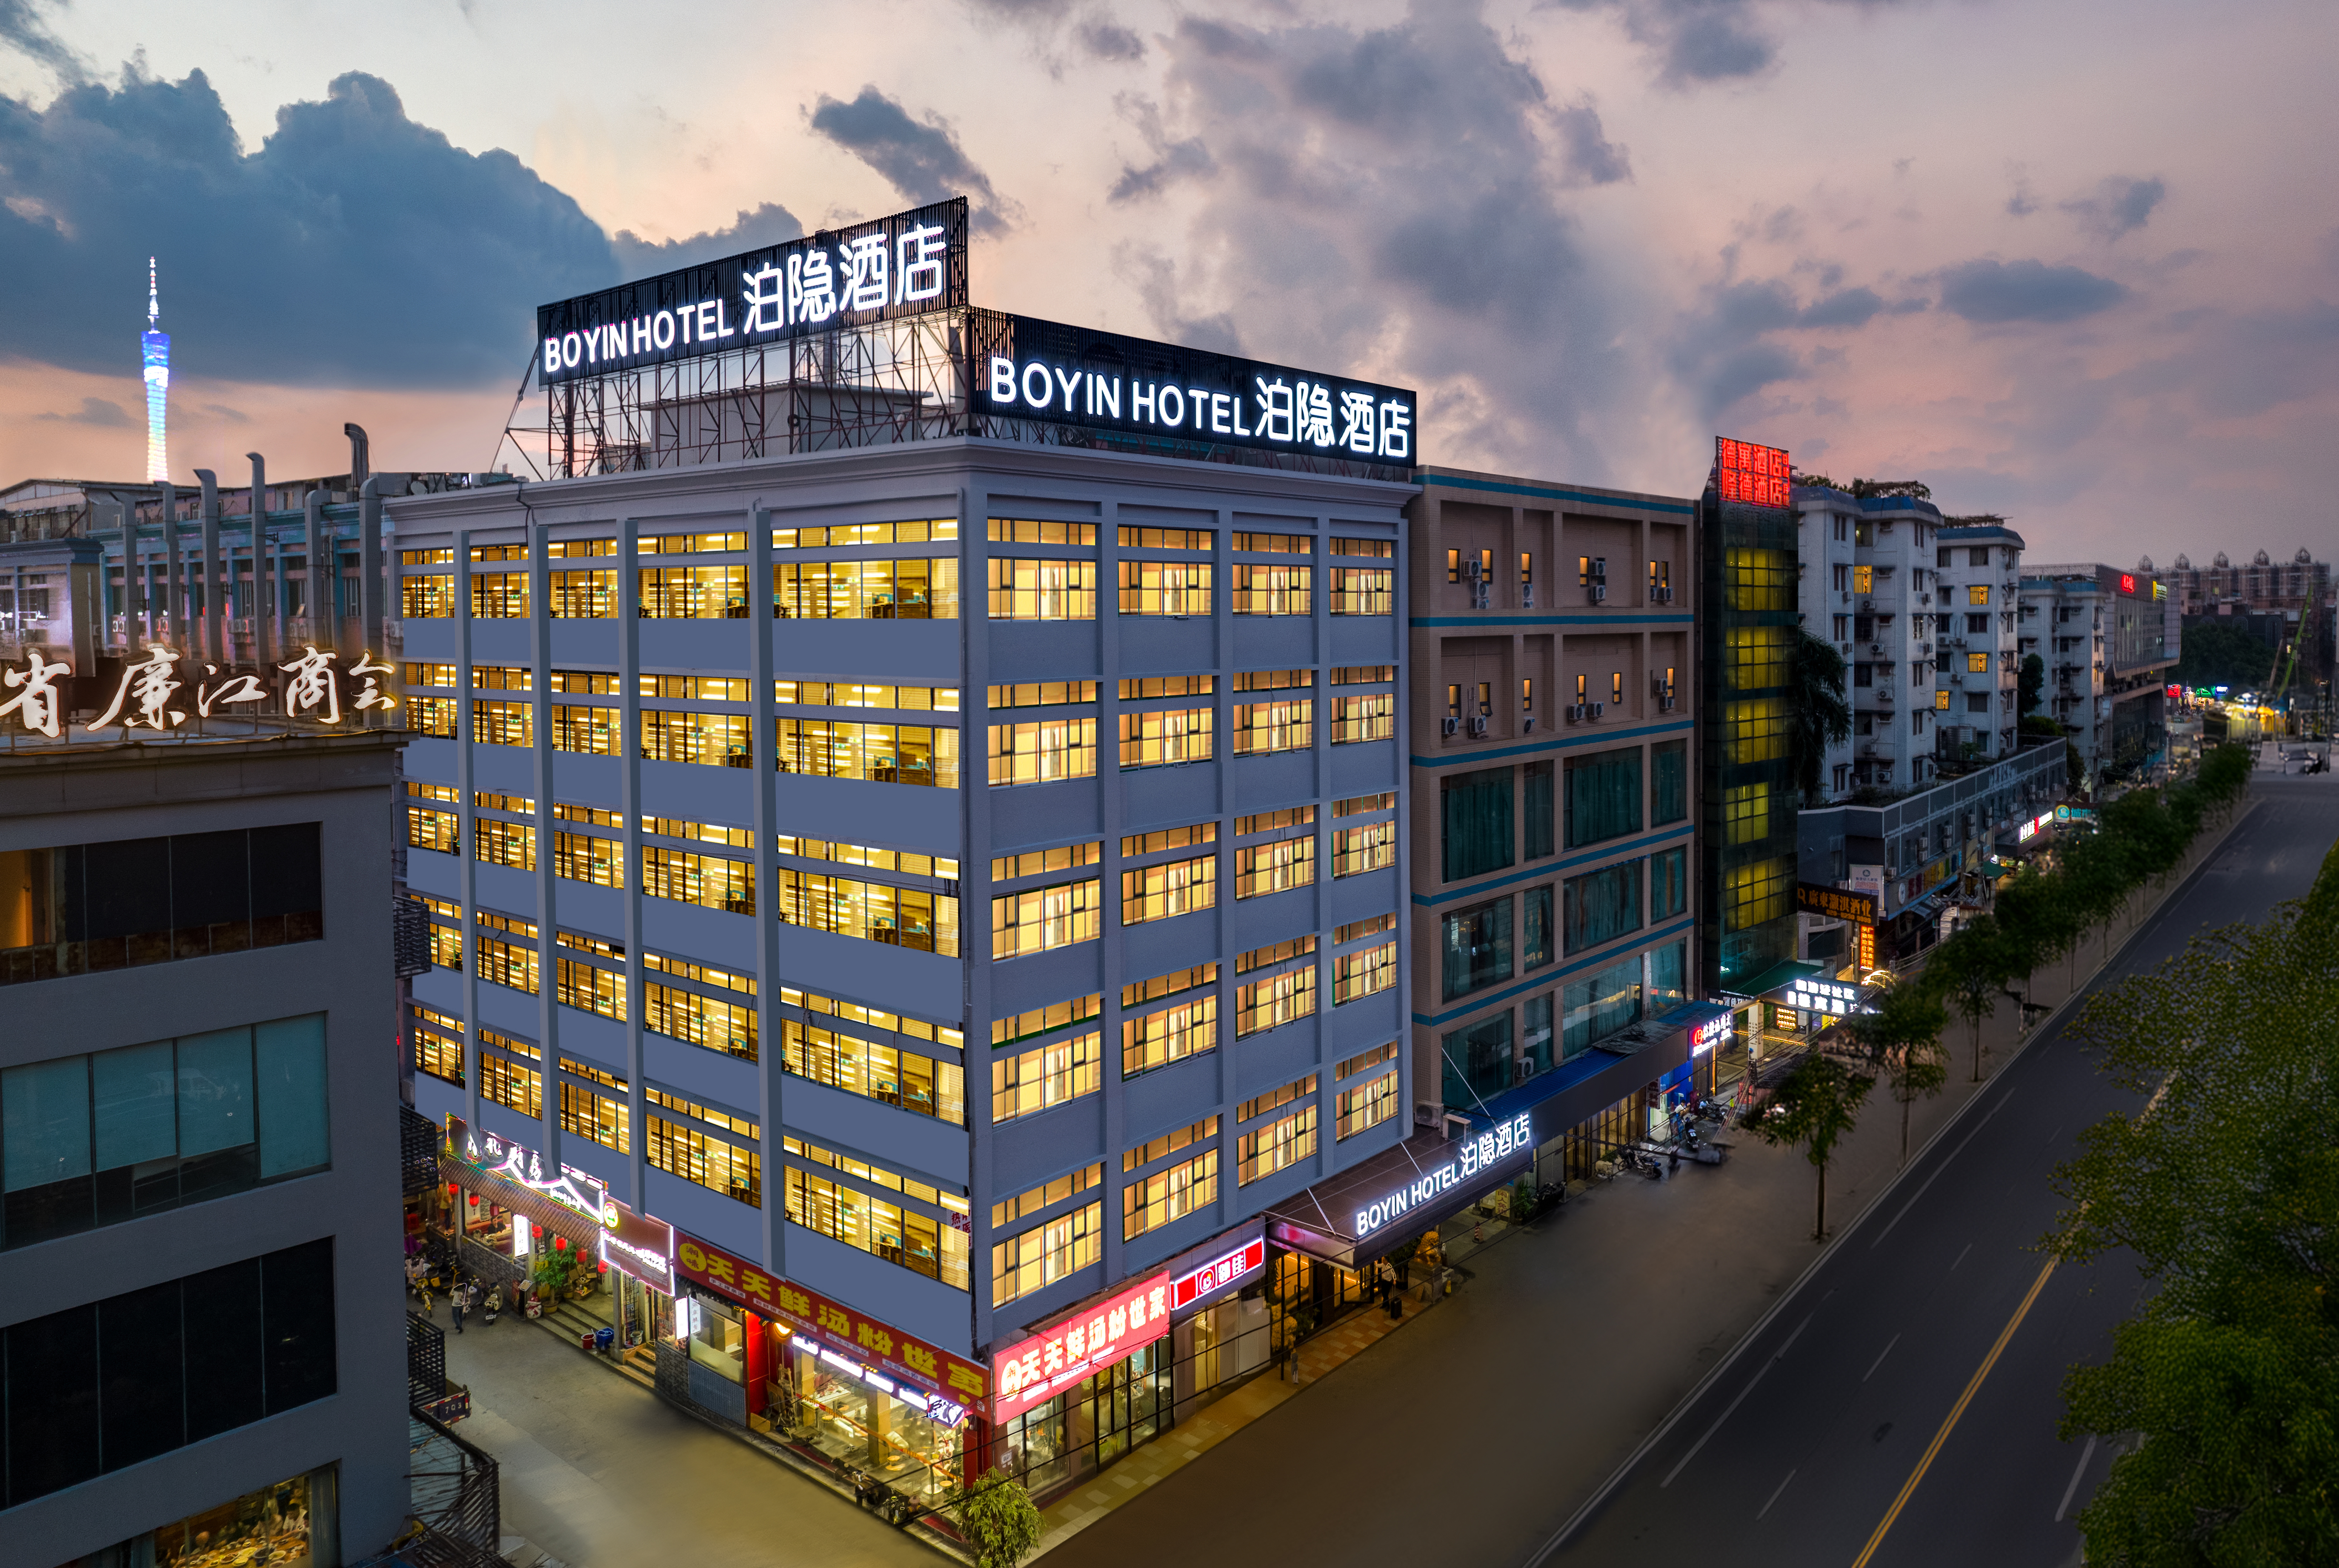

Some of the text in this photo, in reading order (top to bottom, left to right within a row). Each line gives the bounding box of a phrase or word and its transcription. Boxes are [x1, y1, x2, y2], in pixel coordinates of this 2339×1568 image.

[545, 222, 947, 373] BOYIN HOTEL 泊隐酒店
[990, 352, 1411, 458] BOYIN HOTEL 泊隐酒店
[0, 644, 398, 738] 省廉江商会
[1356, 1113, 1530, 1236] BOYIN HOTEL 泊隐酒店
[706, 1253, 983, 1405] 天天鲜汤粉世家
[1021, 1286, 1166, 1387] 天天鲜汤粉世家
